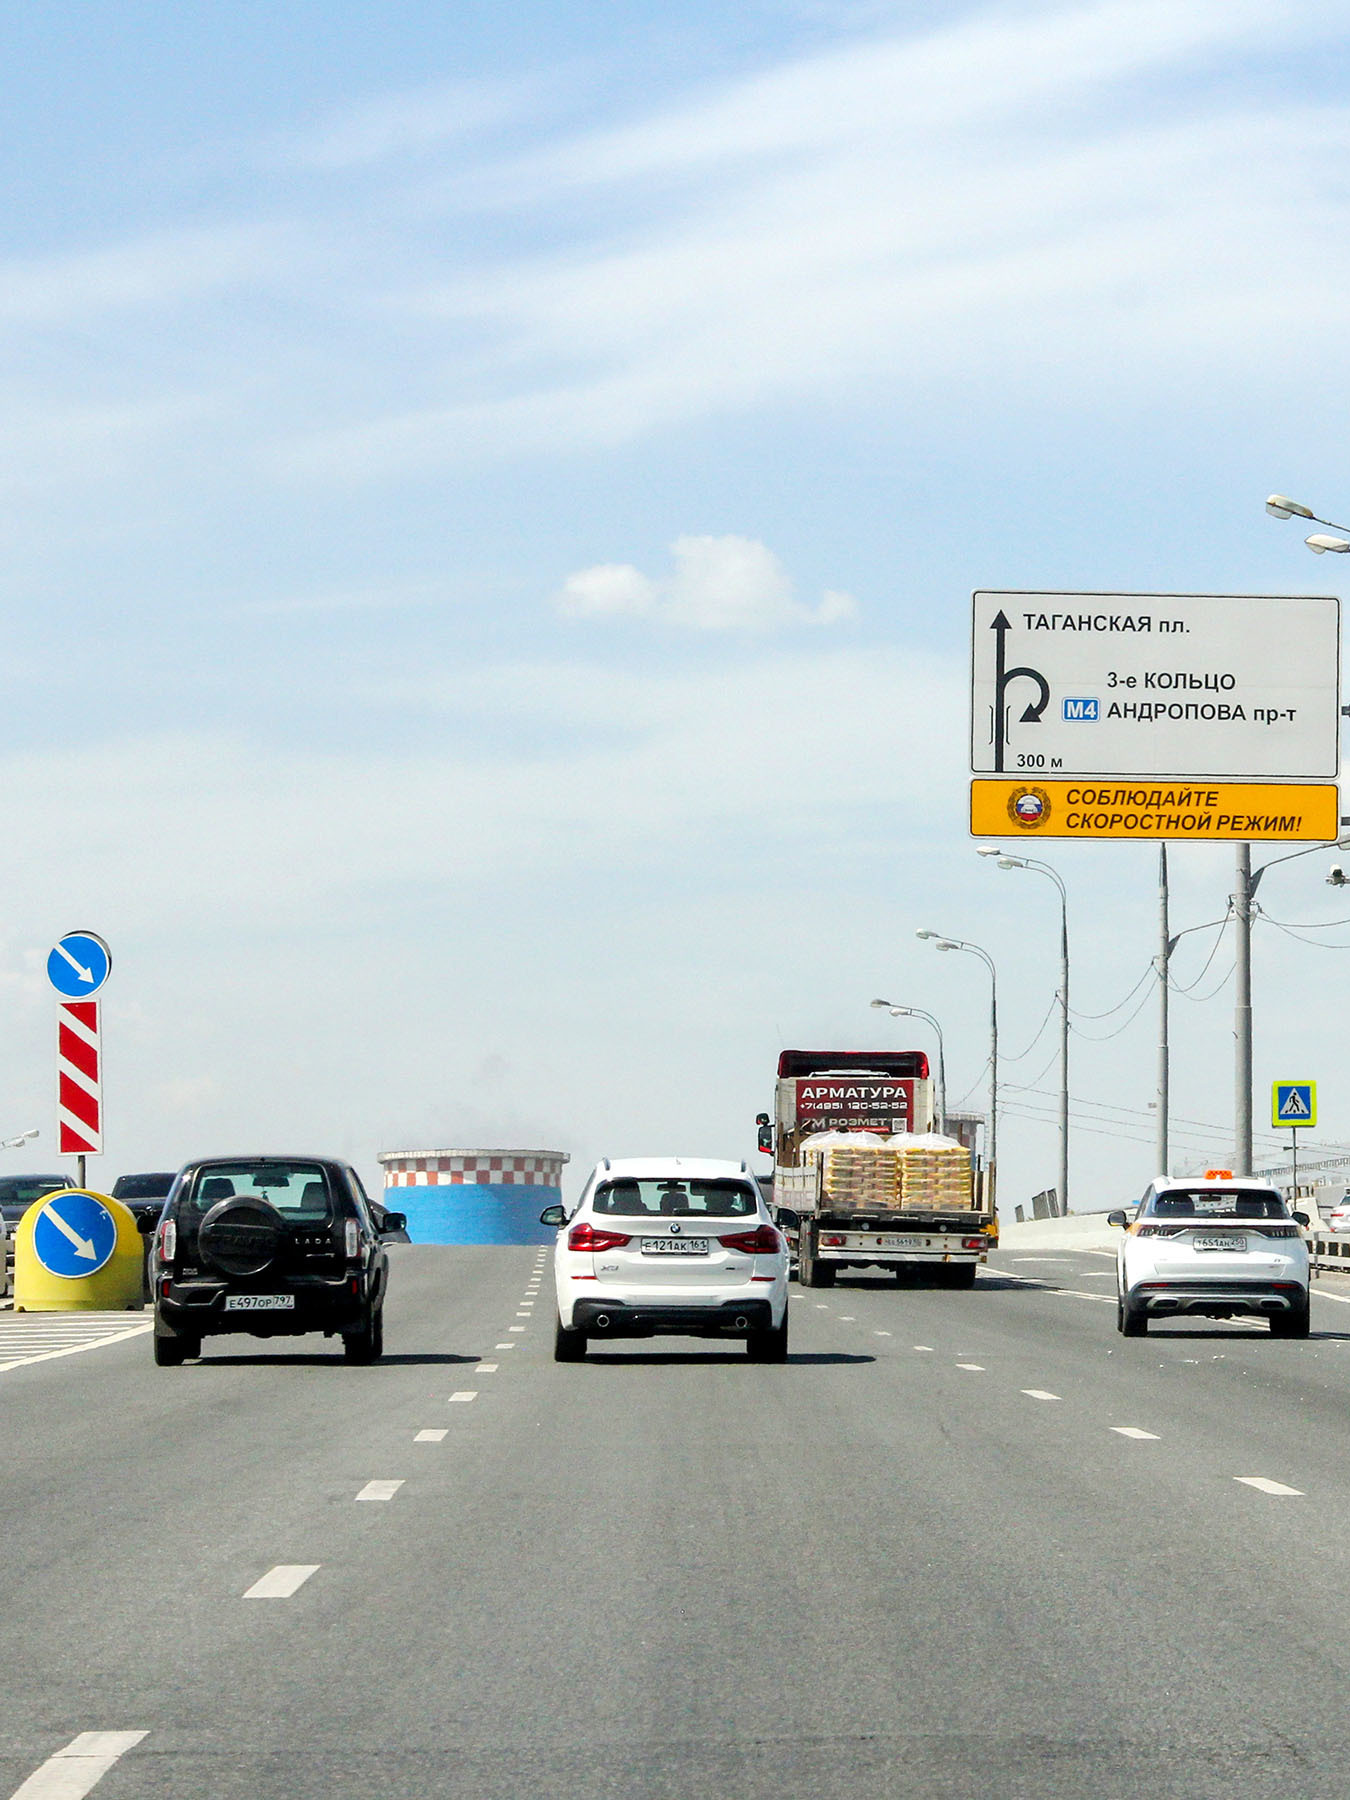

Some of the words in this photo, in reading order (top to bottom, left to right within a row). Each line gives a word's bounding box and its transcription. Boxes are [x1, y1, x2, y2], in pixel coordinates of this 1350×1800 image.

[1023, 613, 1151, 633] ТАГАНСКАЯ
[1159, 621, 1191, 633] пл.
[1107, 672, 1137, 688] 3-е
[1145, 673, 1236, 693] КОЛЬЦО
[1107, 702, 1247, 722] АНДРОПОВА
[1253, 709, 1297, 725] пр-т
[1016, 754, 1045, 768] 300
[1050, 758, 1063, 768] м
[1066, 787, 1219, 810] СОБЛЮДАЙТЕ
[1066, 811, 1212, 830] СКОРОСТНОЙ
[1216, 815, 1302, 832] РЕЖИМ!
[802, 1087, 908, 1099] АРМАТУРА
